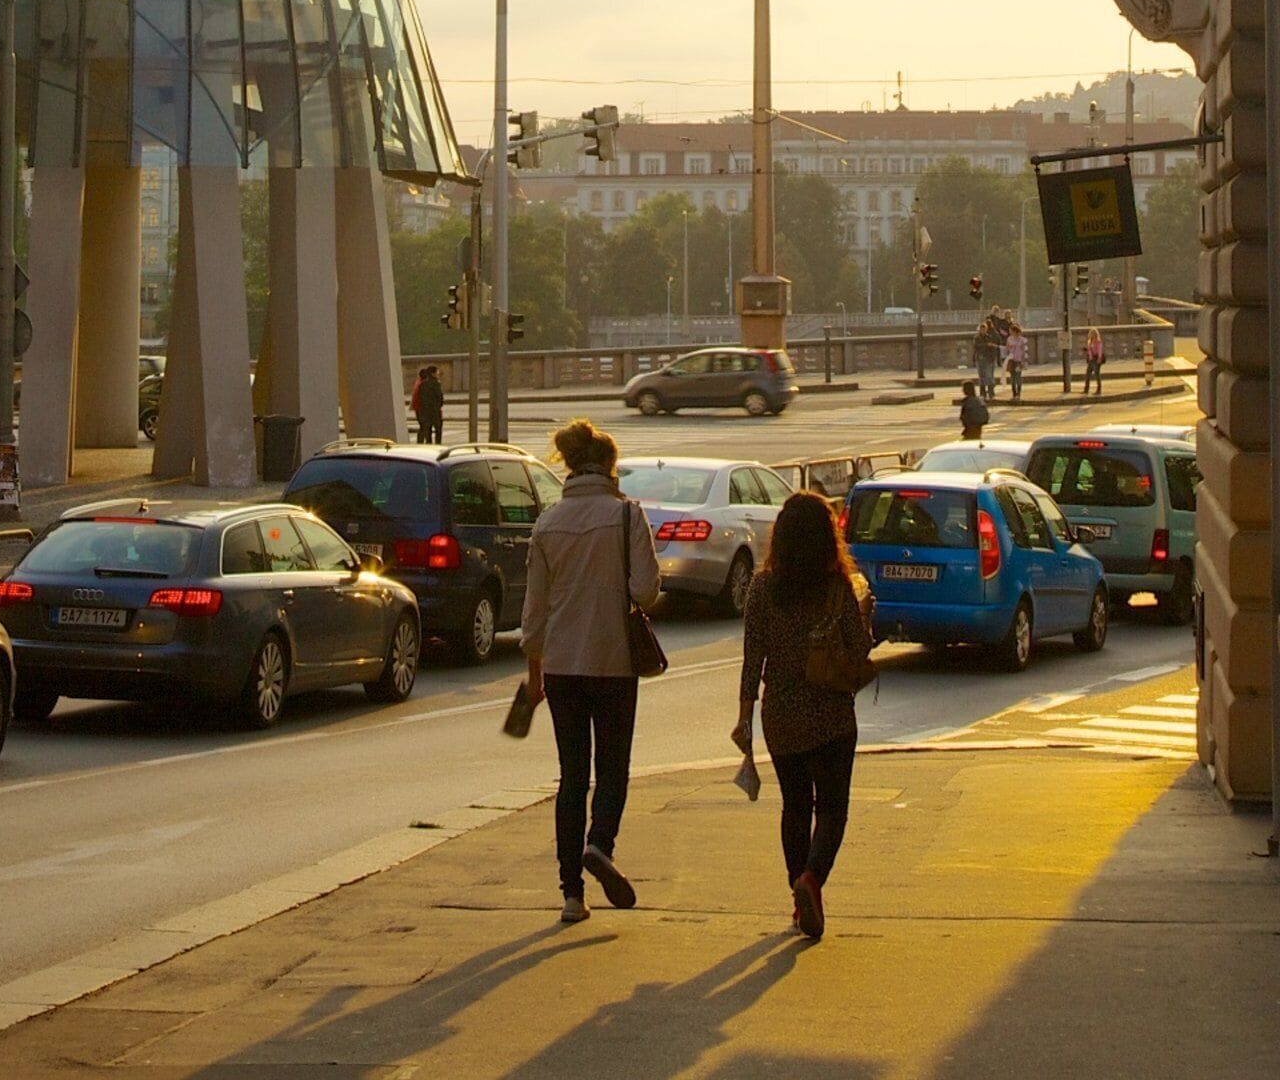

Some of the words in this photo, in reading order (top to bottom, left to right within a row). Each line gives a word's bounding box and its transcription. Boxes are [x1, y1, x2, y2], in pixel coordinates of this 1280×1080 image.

[1082, 219, 1115, 232] HUSA
[909, 567, 933, 578] 7070
[60, 608, 82, 623] 5A7
[90, 610, 120, 624] 1174
